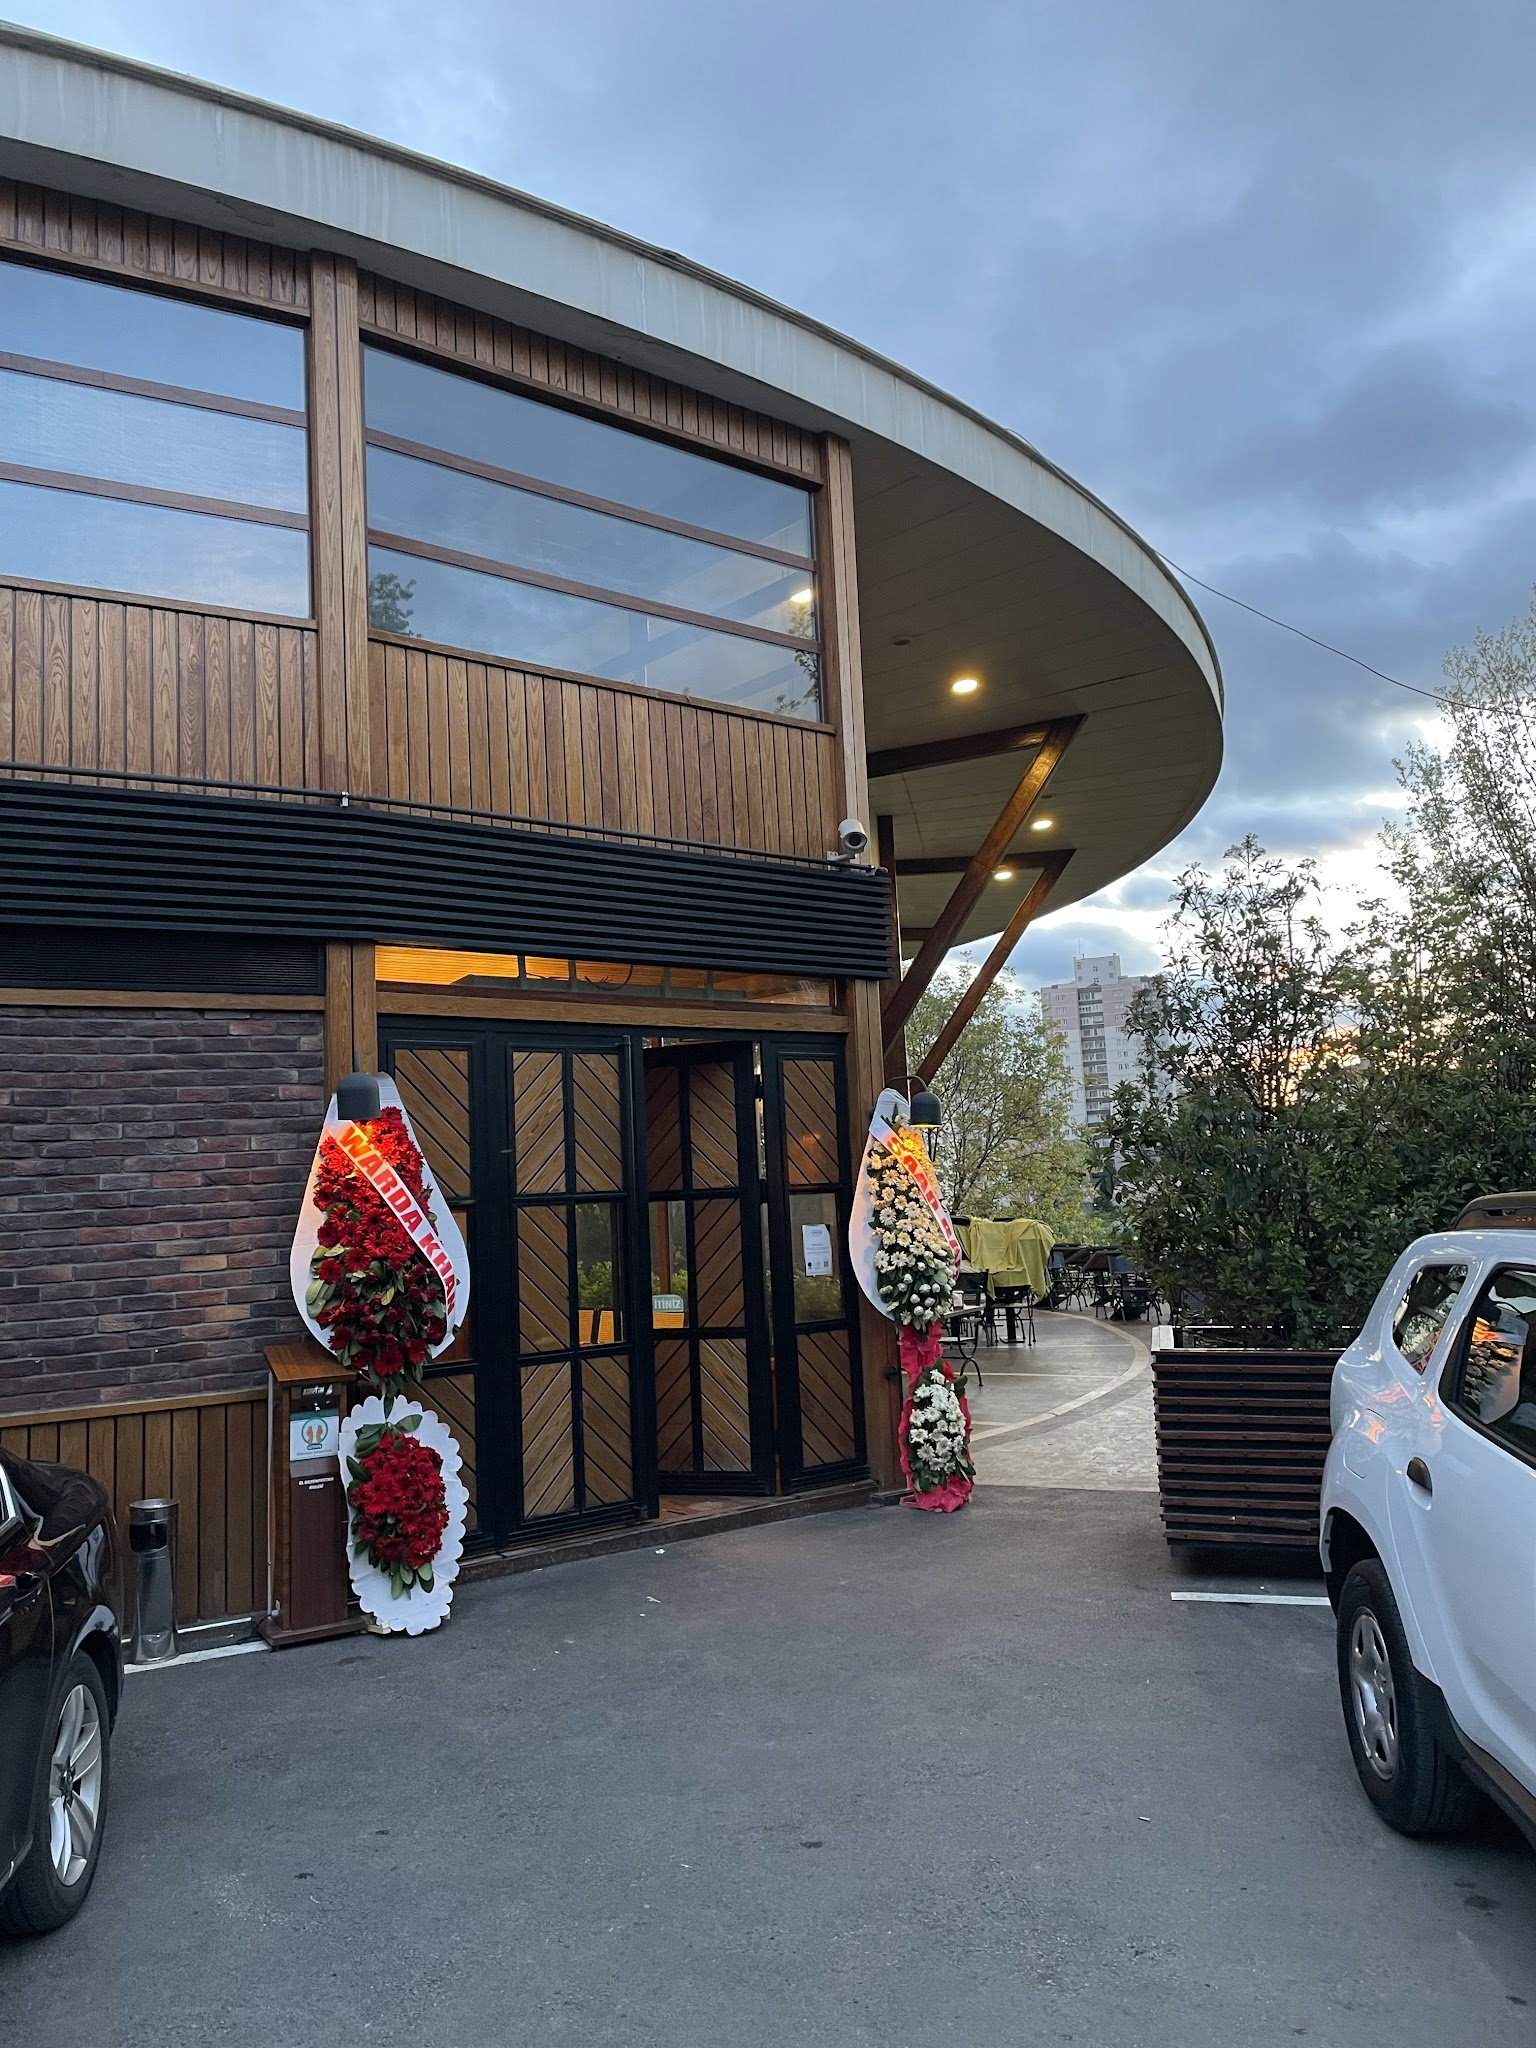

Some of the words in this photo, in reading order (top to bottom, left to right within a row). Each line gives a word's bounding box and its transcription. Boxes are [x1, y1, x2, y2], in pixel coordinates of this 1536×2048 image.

[339, 1125, 424, 1233] WARDA
[419, 1233, 457, 1316] KHAN
[886, 1136, 940, 1213] SAAD
